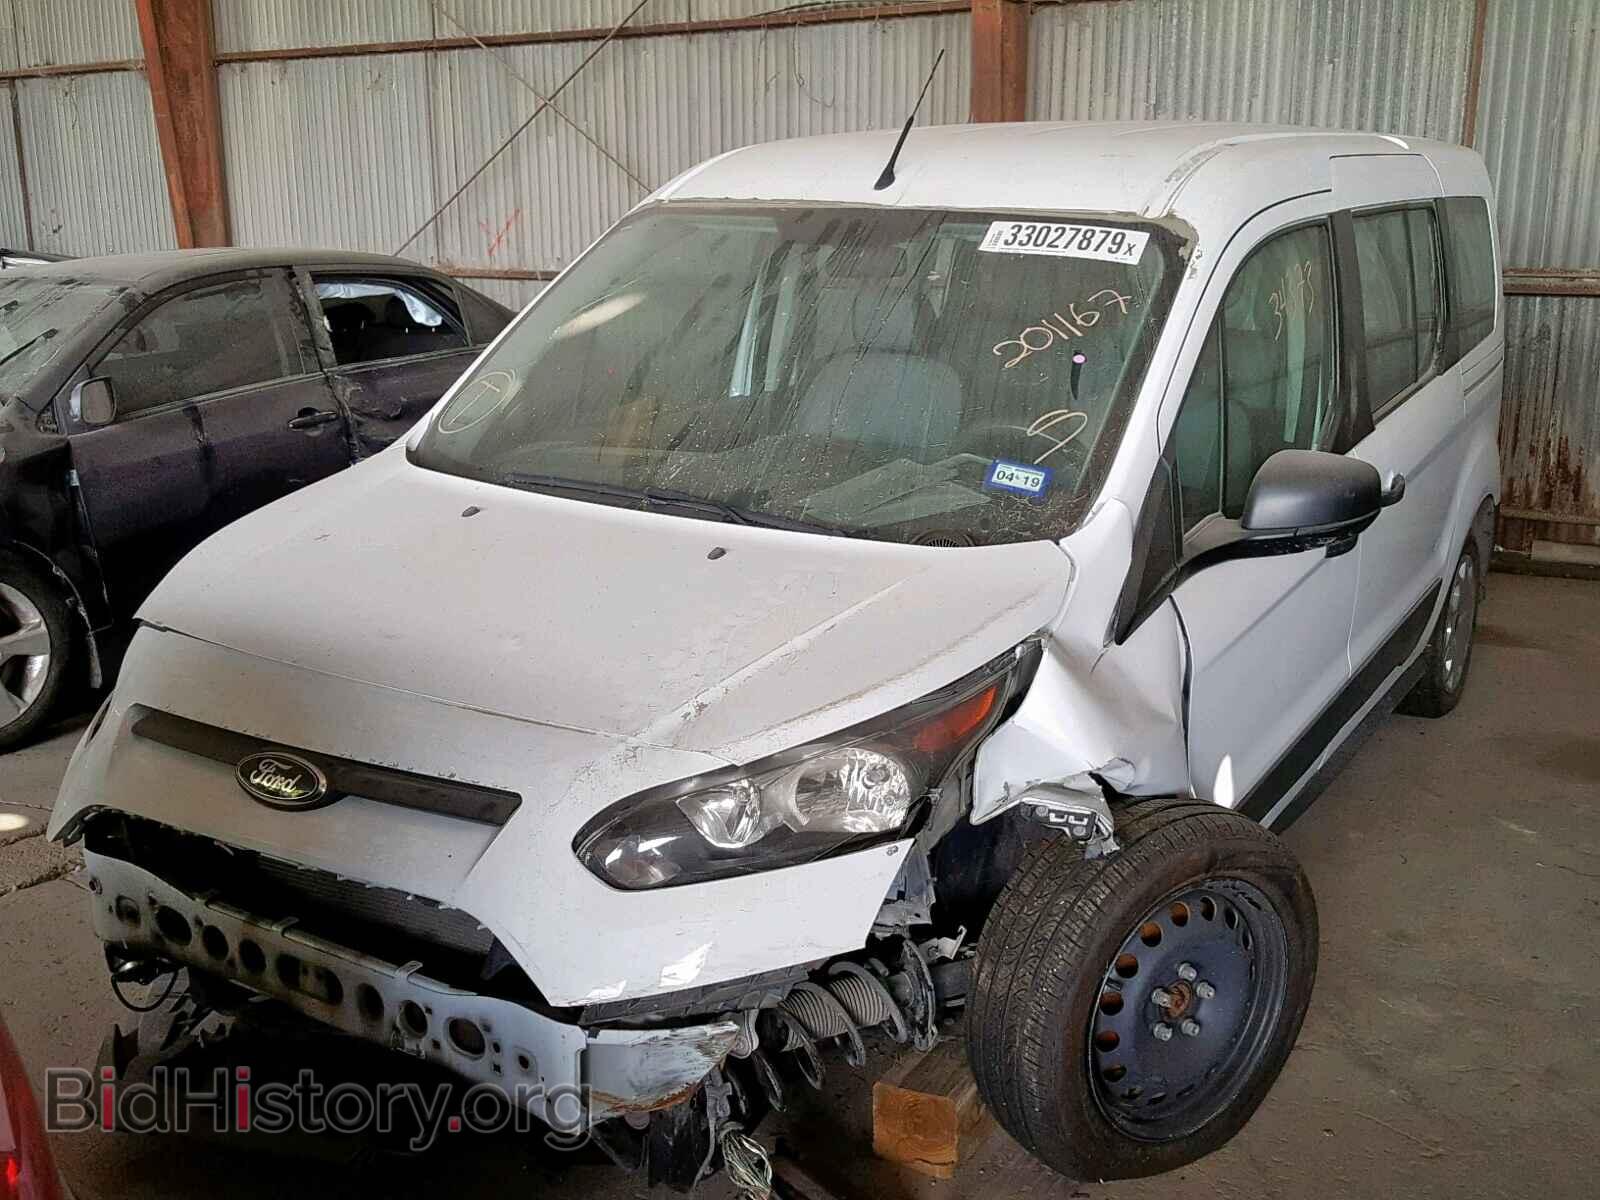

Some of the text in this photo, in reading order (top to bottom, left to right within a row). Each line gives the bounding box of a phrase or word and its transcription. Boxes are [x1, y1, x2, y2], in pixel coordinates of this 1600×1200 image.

[1003, 223, 1127, 255] 33027879
[996, 470, 1015, 482] 04
[1022, 475, 1041, 488] 19
[249, 758, 303, 794] Ford
